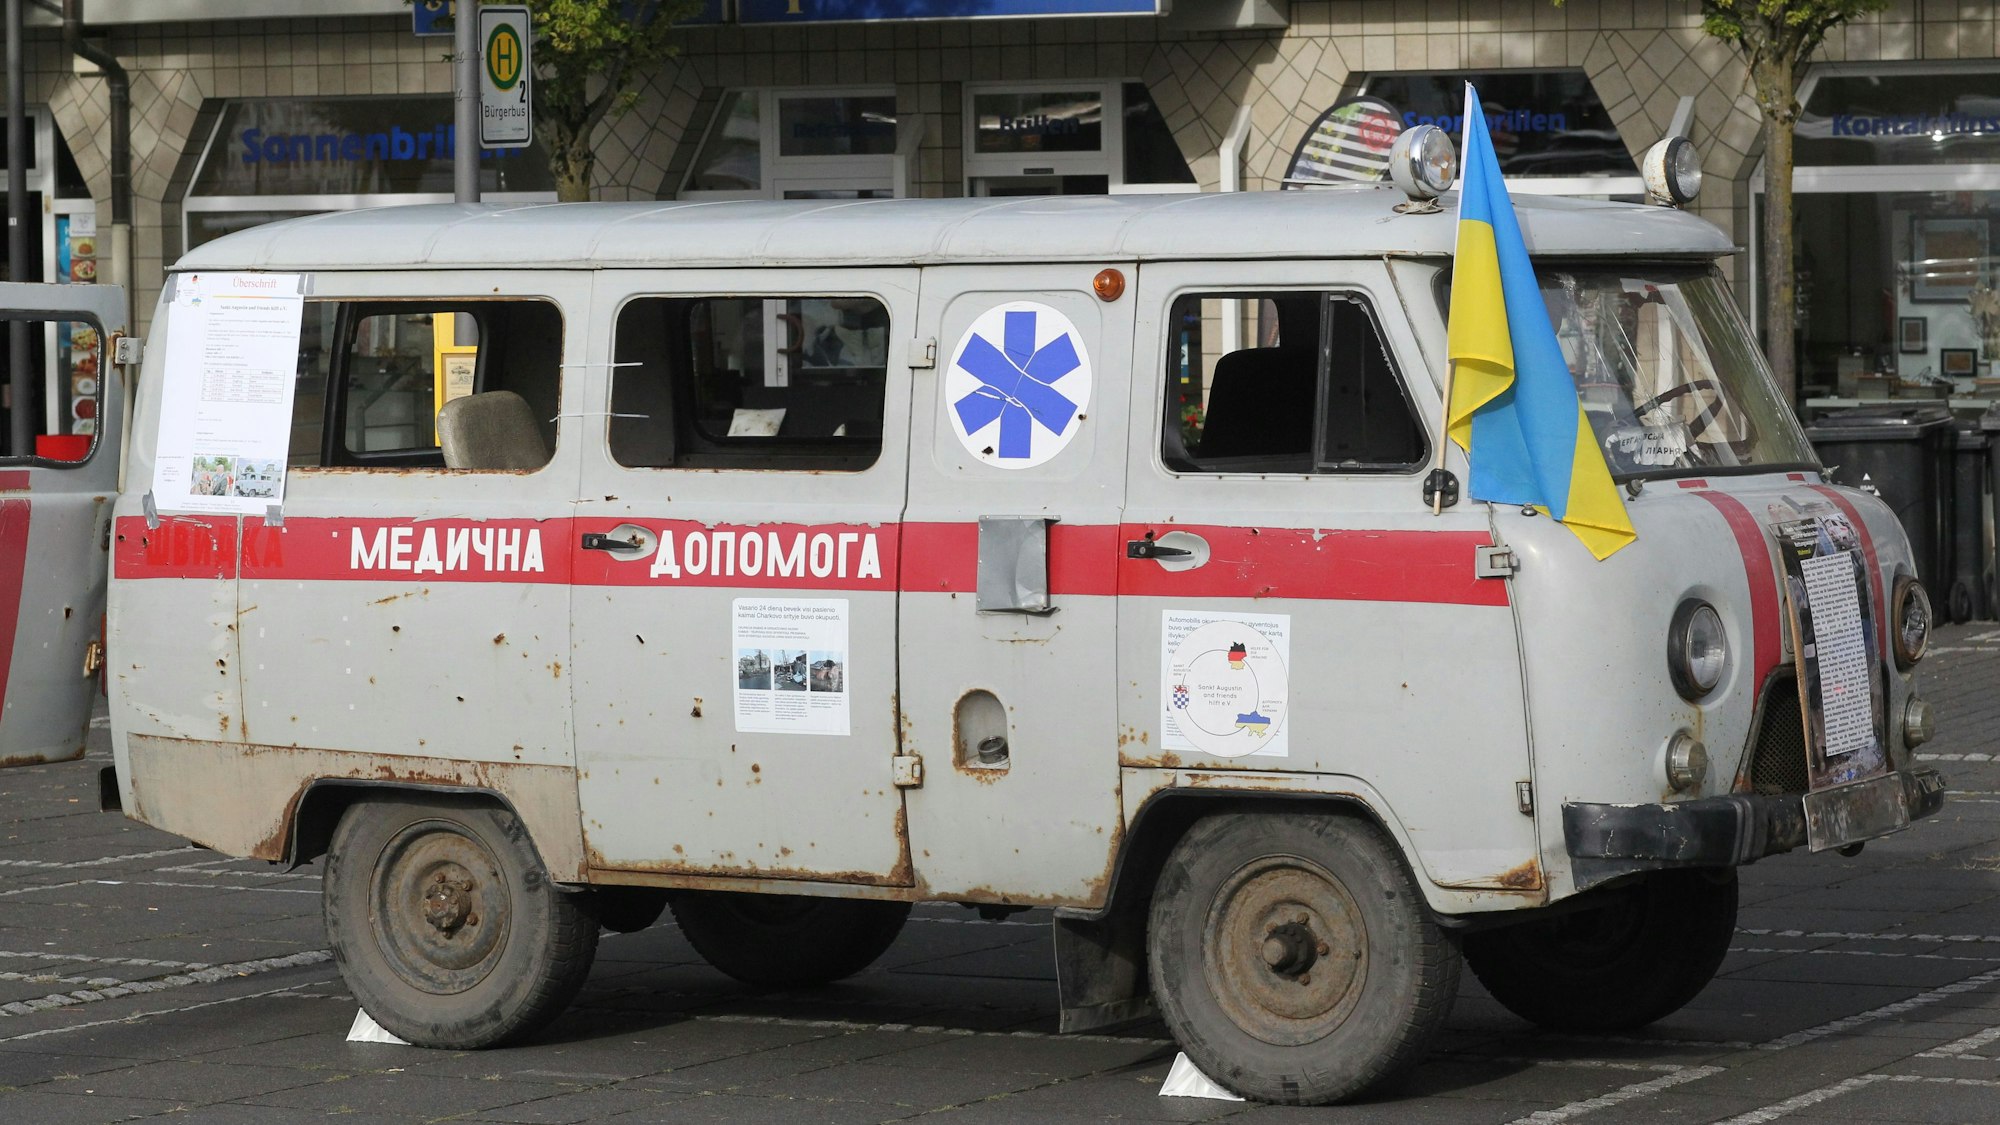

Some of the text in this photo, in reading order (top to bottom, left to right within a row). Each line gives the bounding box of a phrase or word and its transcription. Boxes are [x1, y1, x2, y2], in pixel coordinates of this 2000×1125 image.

[519, 80, 526, 104] 2
[484, 105, 526, 121] Bürgerbus
[998, 112, 1080, 136] Brillen
[241, 124, 520, 163] Sonnenbril
[233, 276, 277, 289] Überschrift
[350, 526, 545, 575] МЕДИЧНА
[650, 529, 881, 579] ДОПОМОГА
[1168, 616, 1201, 624] Automobilis
[1217, 684, 1243, 692] Augustin
